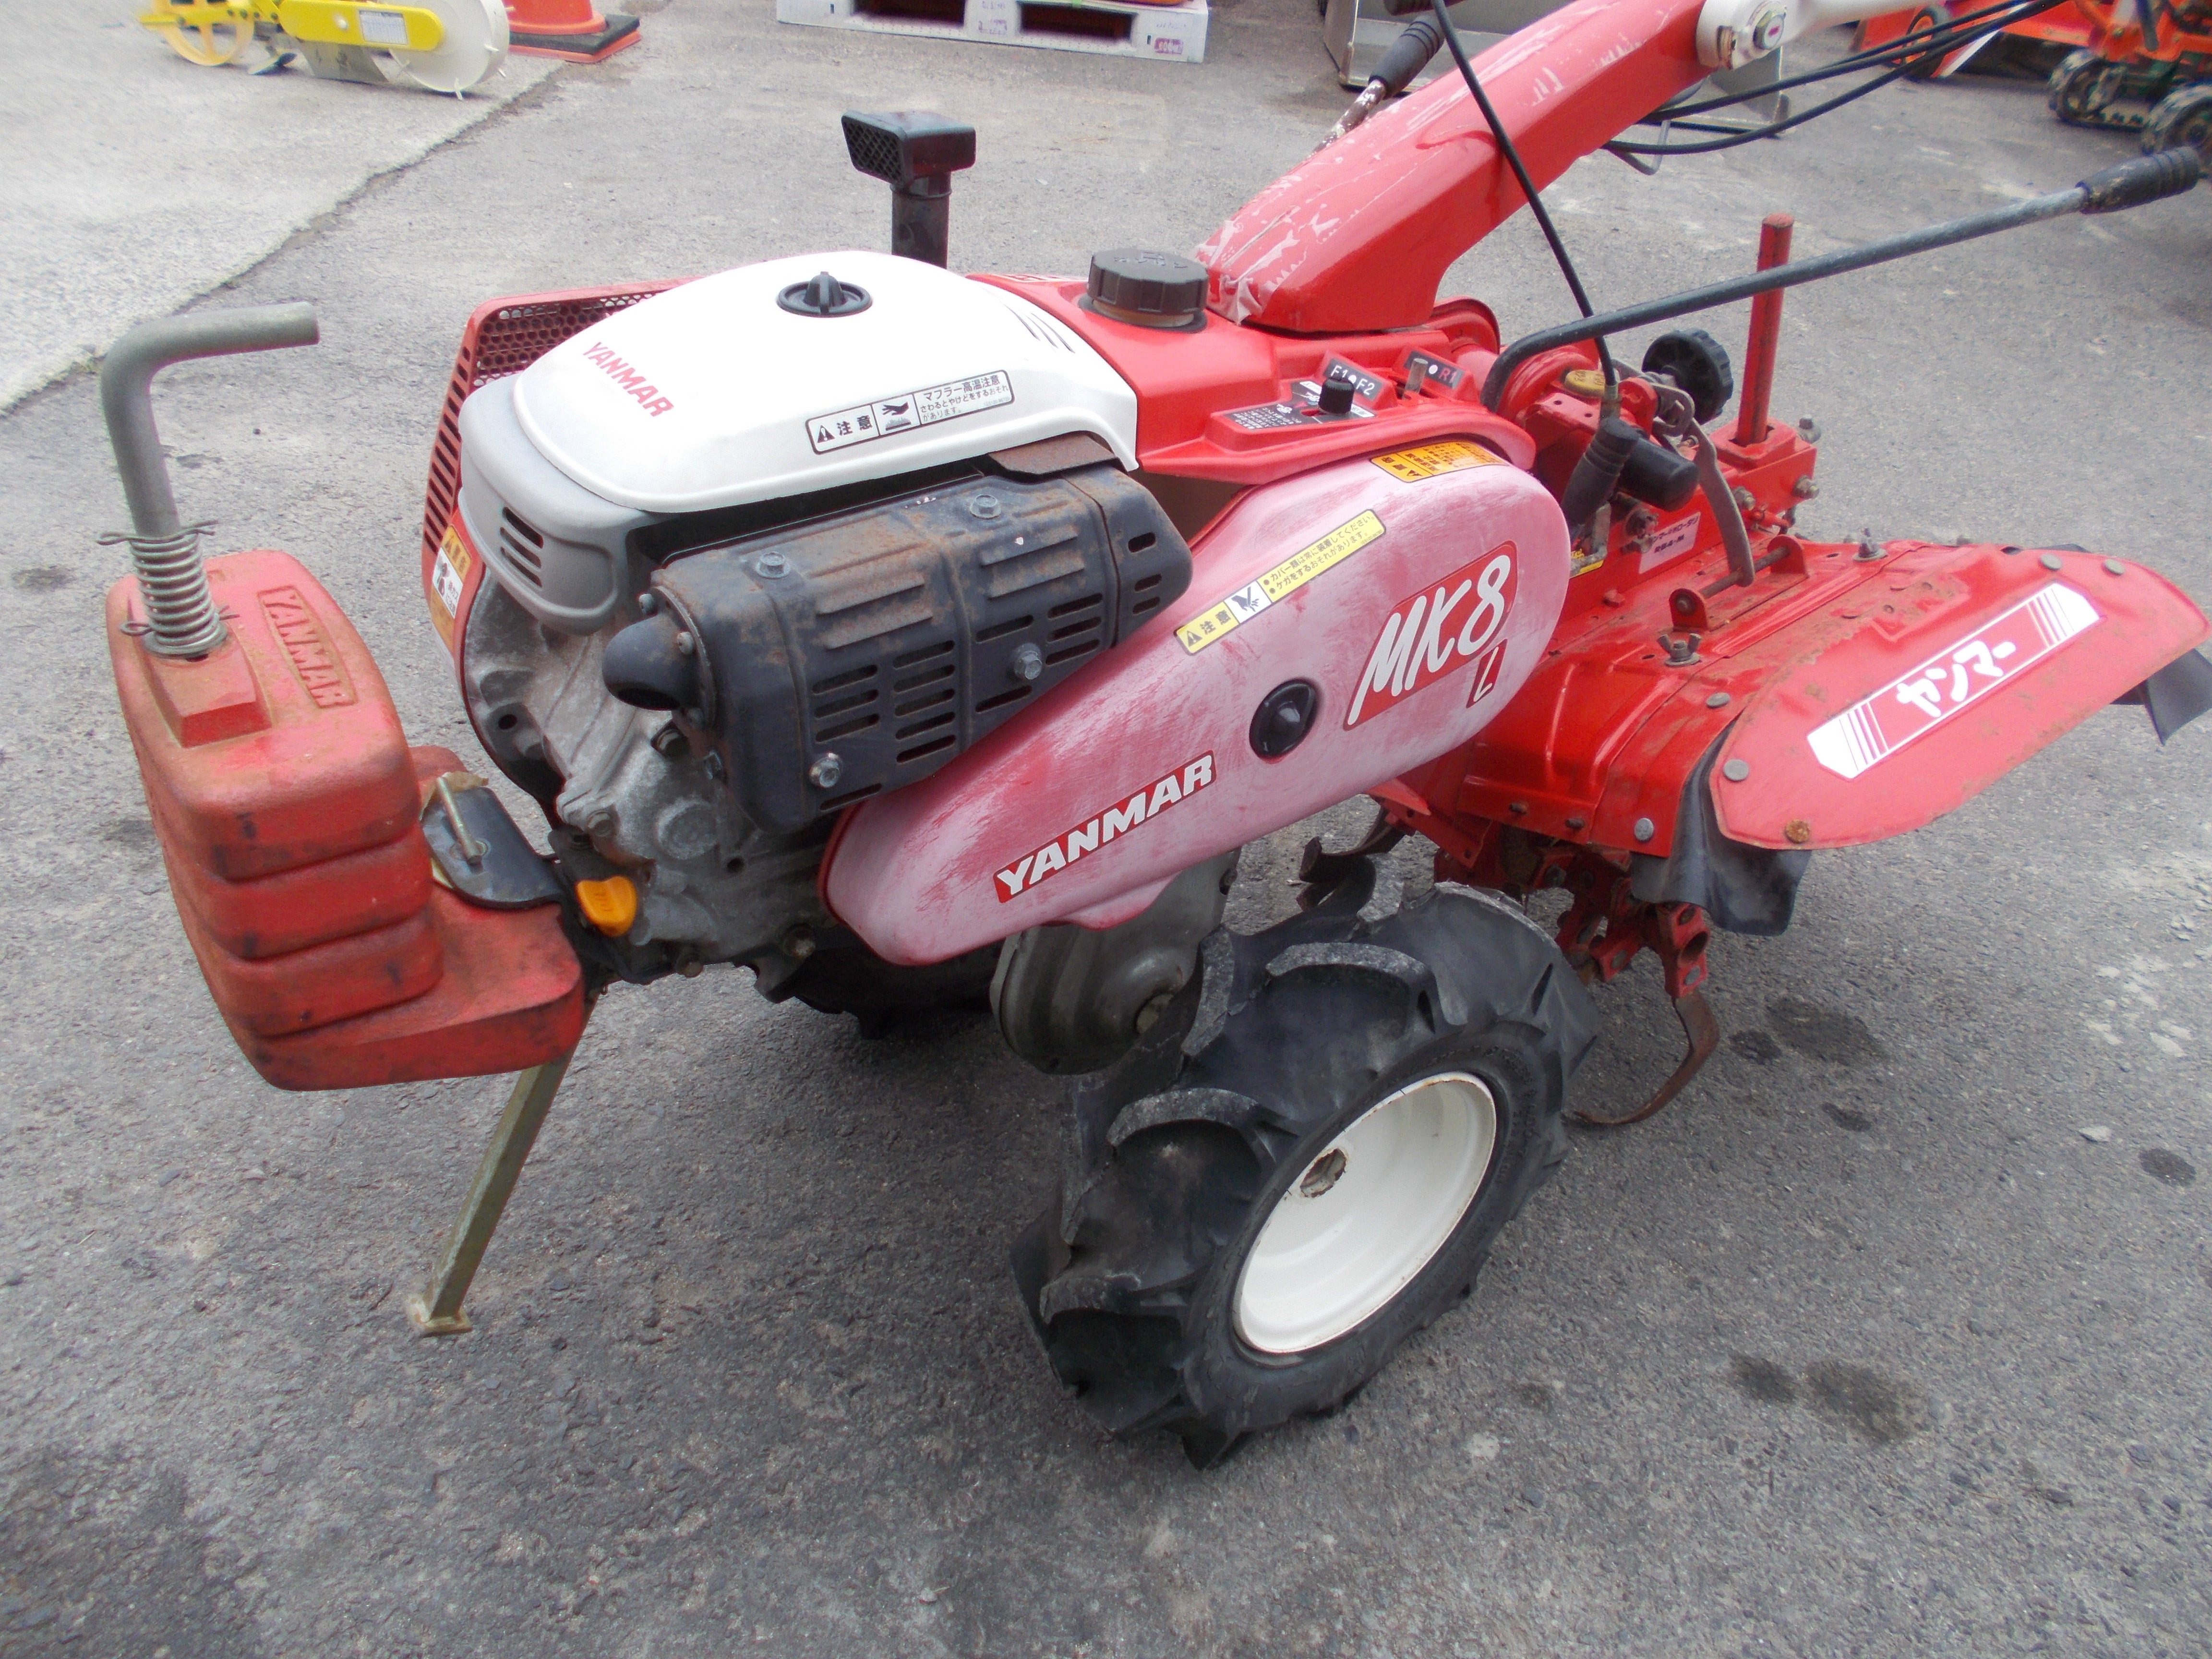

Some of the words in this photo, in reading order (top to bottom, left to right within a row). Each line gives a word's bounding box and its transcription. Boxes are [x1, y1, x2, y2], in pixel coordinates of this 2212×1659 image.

[583, 341, 674, 417] YANMAR
[923, 374, 1001, 401] マフラー高温注意
[1331, 364, 1348, 378] F1
[1356, 378, 1375, 396] F2
[1438, 367, 1457, 384] R1
[920, 385, 1009, 413] さわるとやけどをするおそれ
[922, 406, 962, 422] があります。
[836, 415, 873, 436] 注意
[1270, 515, 1375, 582] カバー類は常に装着してください。
[1275, 531, 1368, 590] ケガをするおそれがあります。
[1201, 609, 1232, 635] 注意
[1347, 554, 1511, 725] MK8
[1473, 647, 1499, 702] L
[1896, 640, 2016, 718] ヤンマー
[997, 755, 1212, 896] YANMAR
